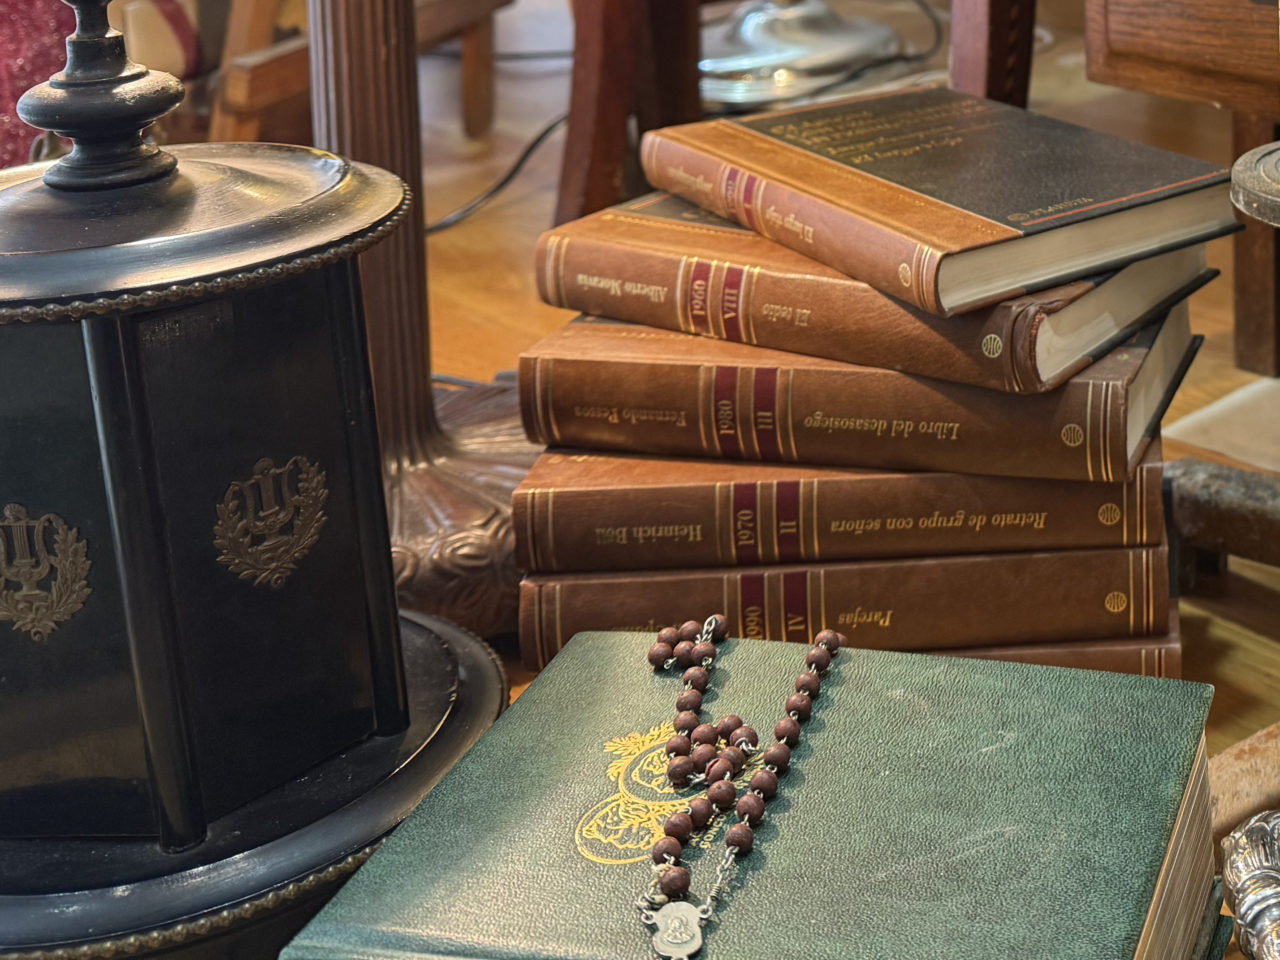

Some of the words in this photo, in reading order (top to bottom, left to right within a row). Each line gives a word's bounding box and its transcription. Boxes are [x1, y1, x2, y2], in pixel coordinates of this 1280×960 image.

[576, 273, 623, 296] Moravia
[625, 278, 669, 303] Alberto
[692, 279, 706, 316] 1960
[723, 288, 738, 320] VIII
[762, 302, 795, 322] tedio
[795, 308, 812, 328] El
[621, 406, 687, 427] Fernando
[719, 399, 735, 435] 1980
[757, 411, 773, 430] III
[804, 411, 888, 437] desasosiego
[890, 419, 915, 438] del
[918, 421, 960, 440] Libro
[737, 509, 755, 547] 1970
[779, 520, 797, 533] II
[830, 518, 882, 535] señora
[886, 517, 914, 531] con
[918, 509, 966, 530] grupo
[968, 515, 988, 531] de
[991, 511, 1048, 529] Retrato
[632, 524, 704, 543] Heinrich
[787, 612, 805, 632] IV
[837, 606, 894, 629] Parejas
